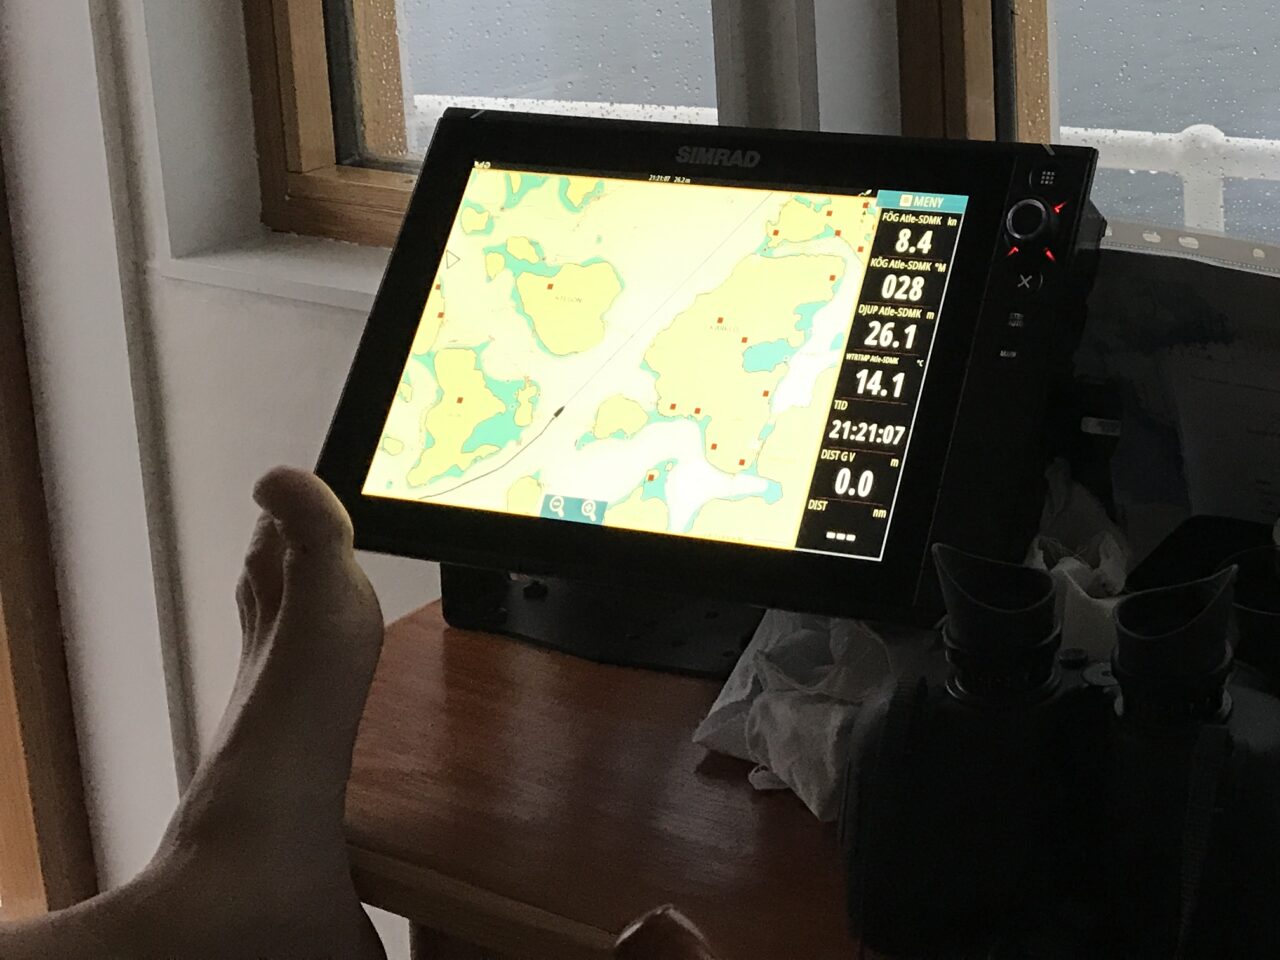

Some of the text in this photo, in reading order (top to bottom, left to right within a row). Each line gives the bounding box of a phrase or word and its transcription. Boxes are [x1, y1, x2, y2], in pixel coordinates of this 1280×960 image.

[675, 145, 761, 168] SIMRAD
[913, 196, 944, 208] MENY
[947, 217, 957, 226] kn
[895, 228, 933, 254] 8.4
[881, 274, 925, 301] 028
[858, 304, 878, 316] DJUP
[926, 311, 935, 319] m
[864, 321, 917, 349] 26.1
[856, 369, 905, 397] 14.1
[834, 400, 848, 411] TID
[829, 420, 905, 445] 21:21:07
[821, 449, 840, 460] DIST
[890, 458, 899, 467] m
[834, 468, 874, 497] 0.0
[808, 500, 887, 518] DIST nm
